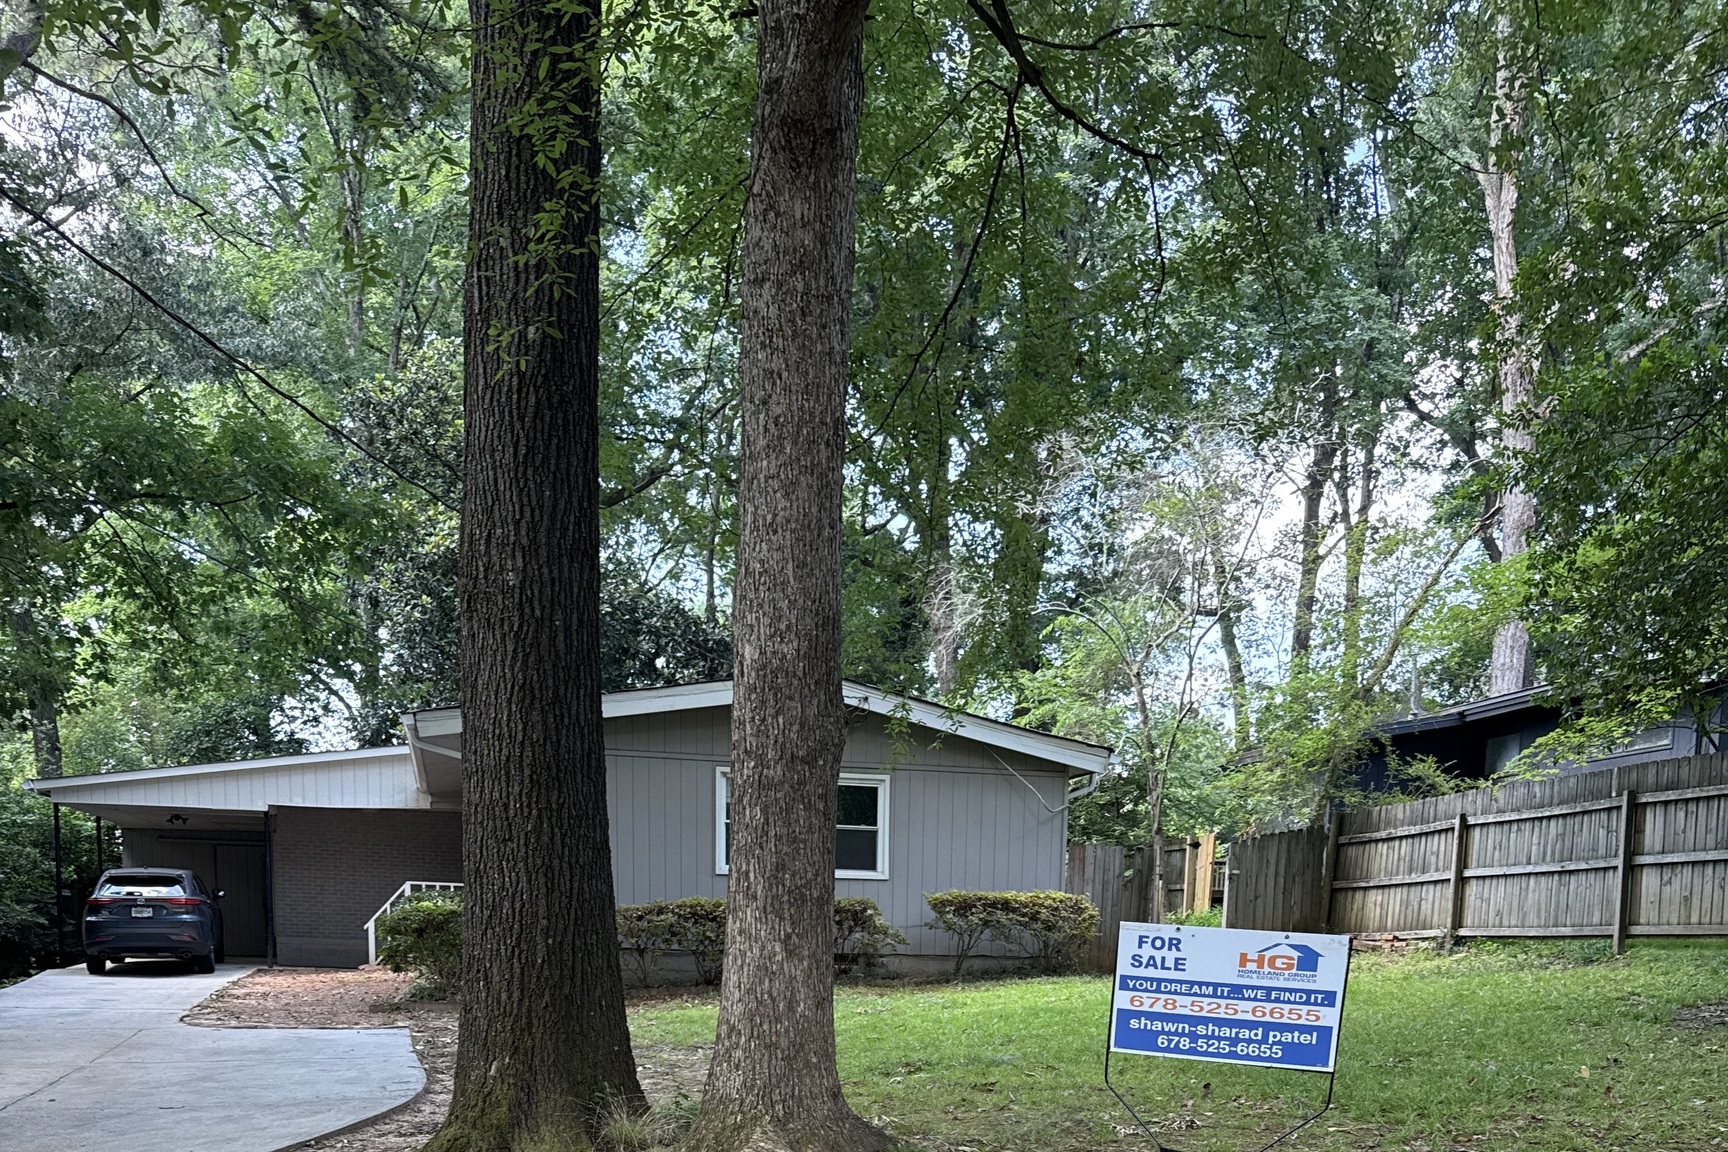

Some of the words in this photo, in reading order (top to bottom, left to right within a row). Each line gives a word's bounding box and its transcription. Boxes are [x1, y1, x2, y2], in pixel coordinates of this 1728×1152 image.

[1137, 935, 1182, 952] FOR
[1130, 954, 1187, 972] SALE
[1238, 952, 1296, 971] HG
[1238, 969, 1285, 977] HOMELAND
[1126, 979, 1156, 990] YOU
[1161, 982, 1213, 996] DREAM
[1272, 991, 1306, 1002] FIND
[1310, 993, 1328, 1004] IT.
[1129, 994, 1321, 1022] 678-525-6655
[1129, 1017, 1263, 1040] shawn-sharad
[1268, 1030, 1317, 1045] patel
[1157, 1035, 1282, 1058] 678-525-6655
